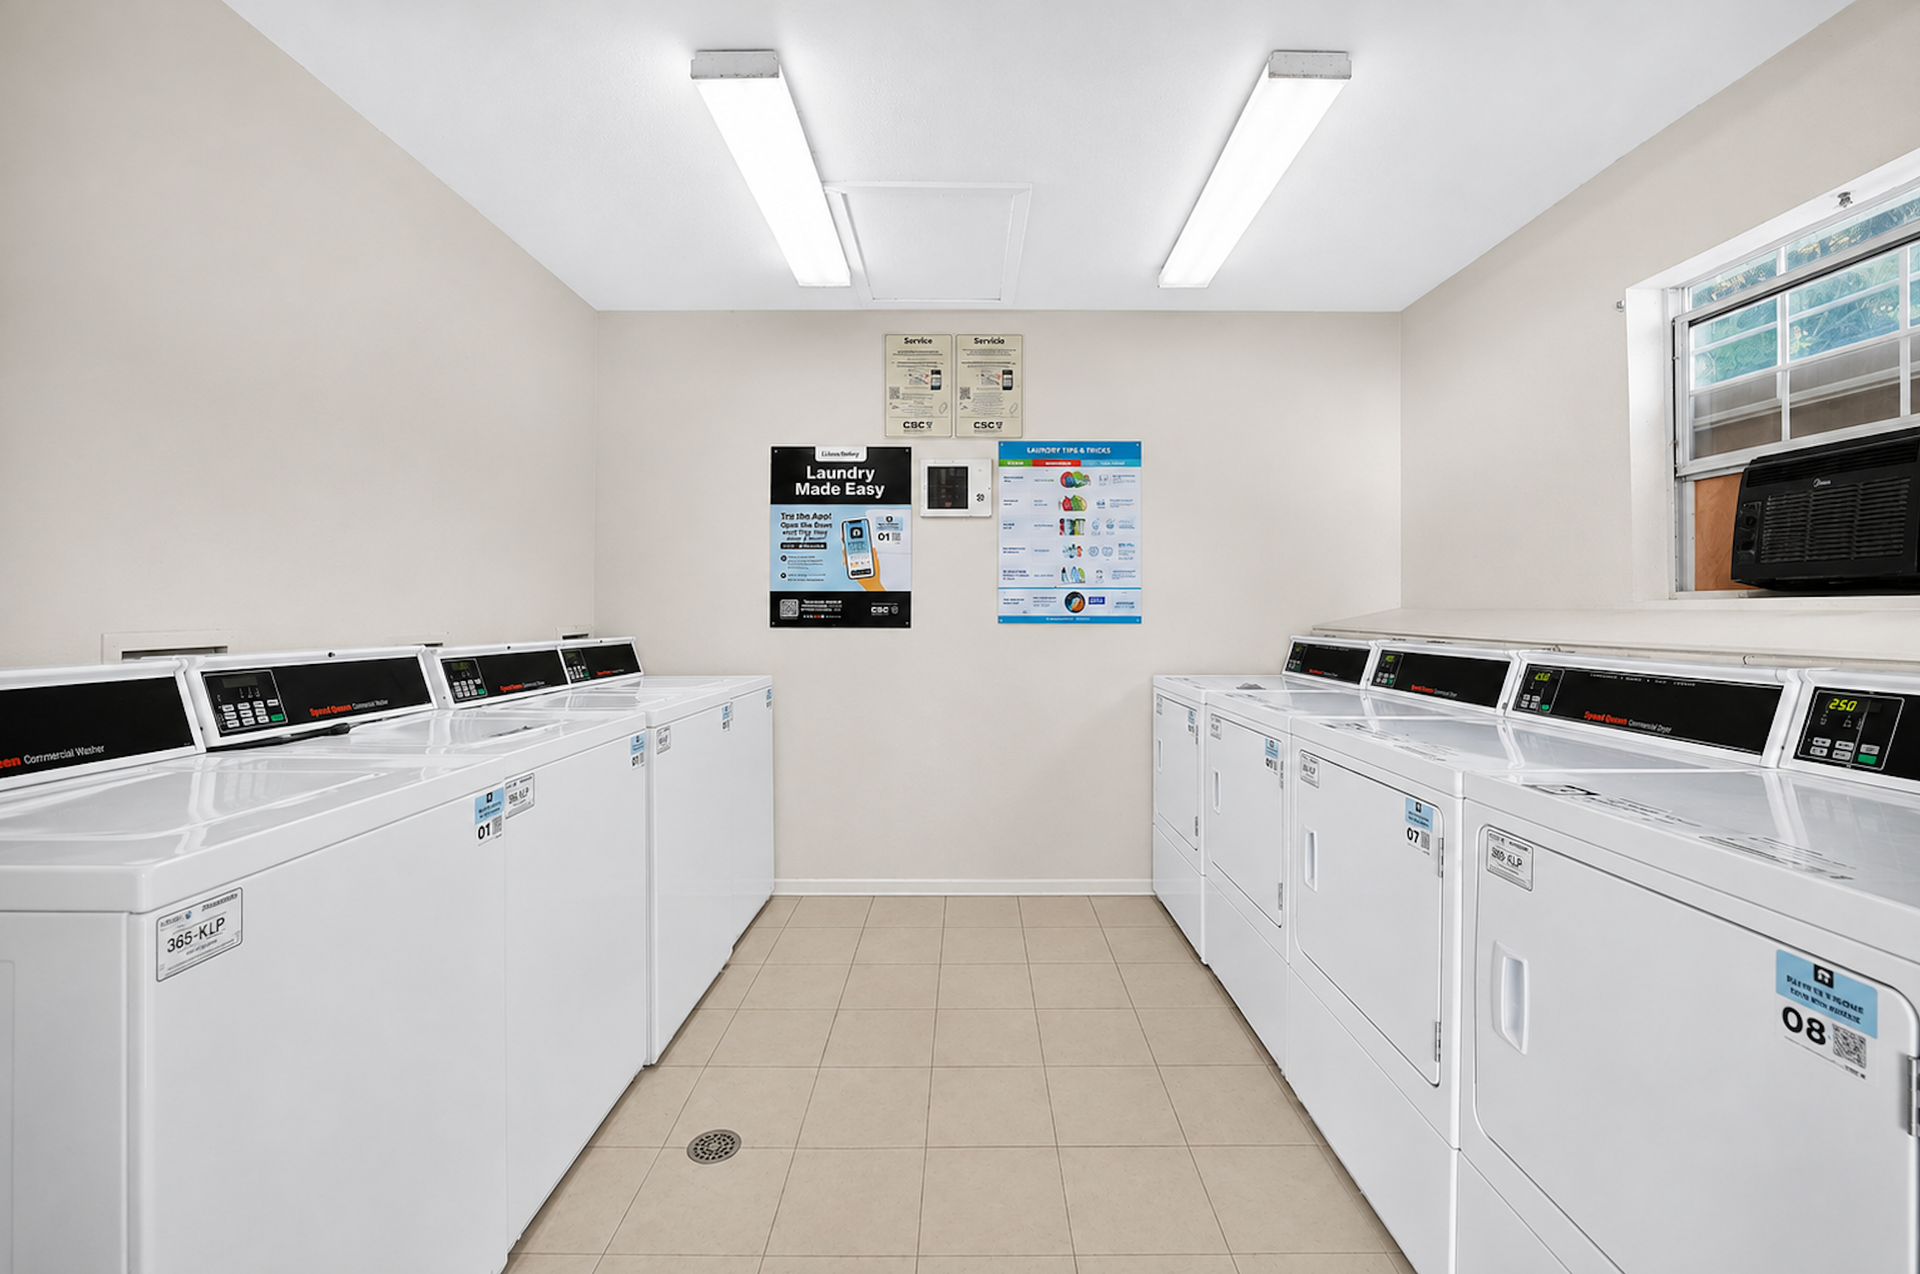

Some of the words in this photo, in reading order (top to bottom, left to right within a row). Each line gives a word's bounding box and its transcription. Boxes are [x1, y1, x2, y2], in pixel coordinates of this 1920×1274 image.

[903, 336, 933, 345] Service
[973, 421, 995, 429] CSC
[806, 465, 875, 483] Laundry
[795, 482, 841, 496] Made
[845, 482, 885, 499] Easy
[878, 532, 890, 541] 01
[1828, 698, 1858, 712] 250
[23, 748, 75, 765] Commercial
[75, 745, 105, 756] Washer
[478, 822, 491, 840] 01
[1406, 827, 1420, 843] 07
[167, 917, 225, 953] 365-KLP
[1782, 1006, 1826, 1045] 08
